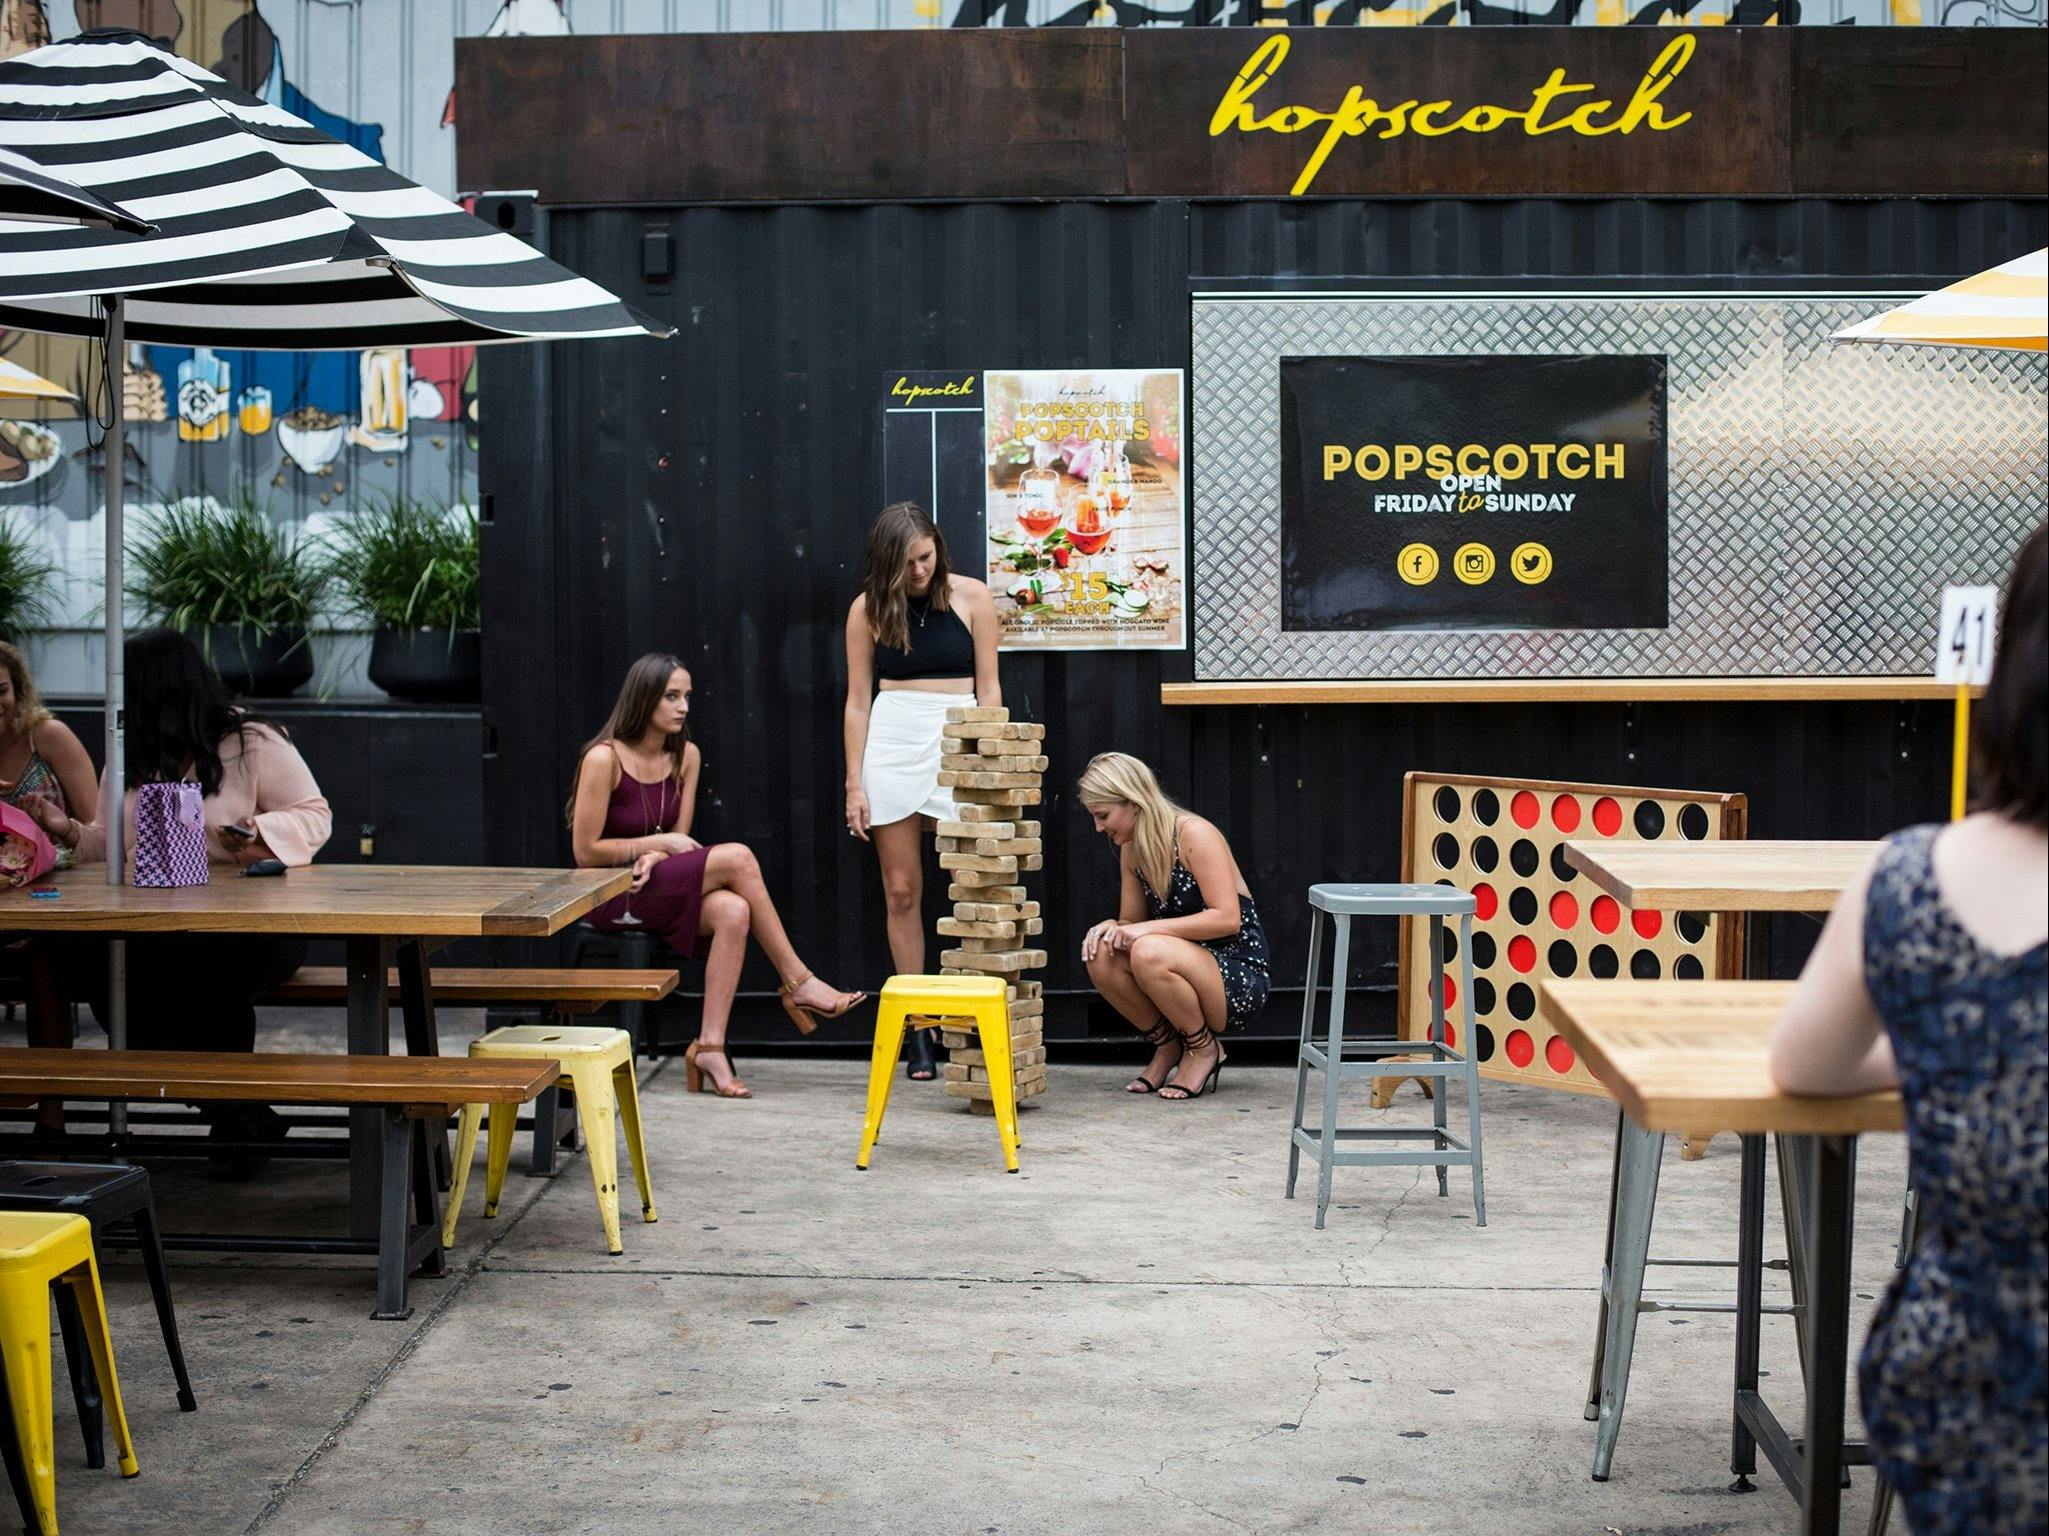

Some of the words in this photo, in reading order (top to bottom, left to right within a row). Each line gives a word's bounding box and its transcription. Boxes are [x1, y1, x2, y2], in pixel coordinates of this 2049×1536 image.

[1209, 33, 1697, 196] hopscotch
[891, 376, 975, 406] hopscotch
[1019, 401, 1145, 419] POPSCOTCH
[1014, 419, 1151, 442] POPTAILS
[1323, 443, 1626, 481] POPSCOTCH
[1440, 474, 1502, 493] OPEN
[1374, 494, 1457, 513] FRIDAY
[1458, 491, 1484, 514] to
[1485, 493, 1576, 512] SUNDAY
[1065, 601, 1110, 615] EACH
[1952, 606, 1985, 666] 41
